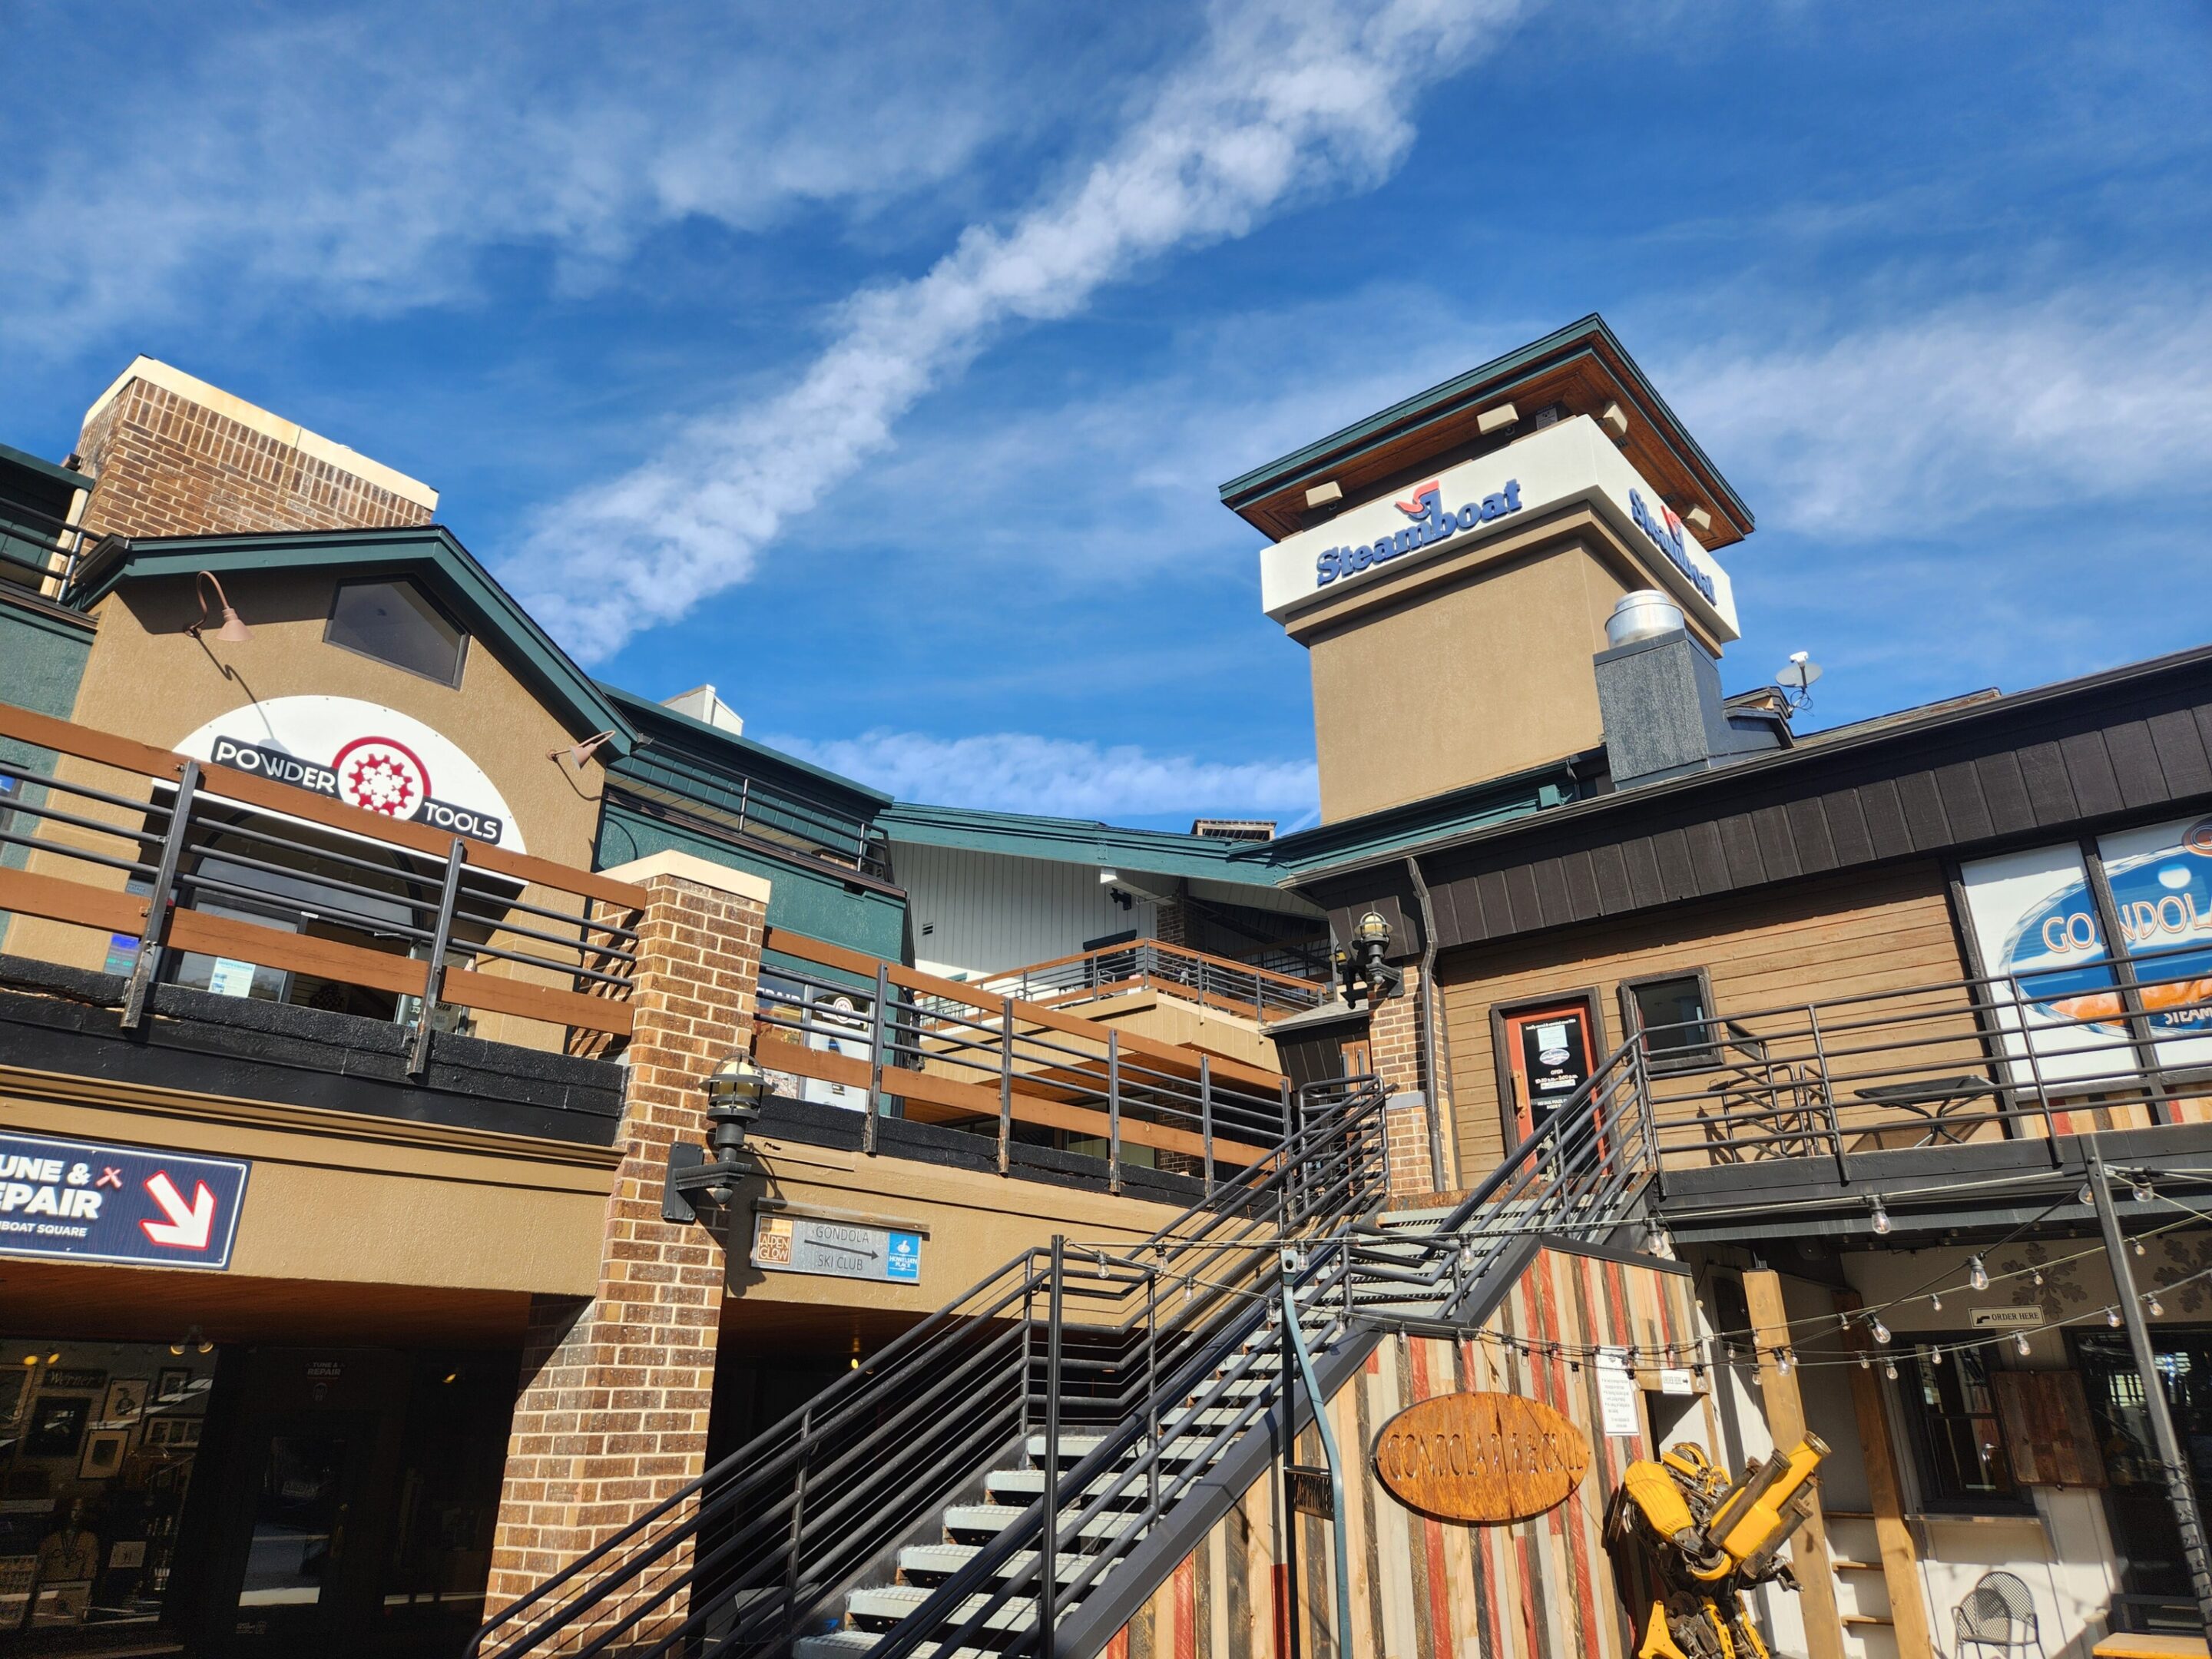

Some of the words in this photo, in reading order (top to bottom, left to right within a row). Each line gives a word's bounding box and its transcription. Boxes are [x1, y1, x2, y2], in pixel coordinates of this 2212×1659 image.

[1316, 478, 1522, 587] Steamboat
[1628, 487, 1717, 606] Steamboat
[215, 741, 336, 794] POWDER
[424, 801, 498, 839] TOOLS
[2042, 893, 2212, 953] GONDOL
[67, 1163, 91, 1187] &
[0, 1220, 36, 1233] BOAT
[37, 1224, 88, 1237] SQUARE
[816, 1226, 869, 1243] GONDOLA
[759, 1233, 790, 1250] ALPEN
[759, 1246, 788, 1260] GLOW
[817, 1254, 833, 1268] SKI
[836, 1257, 863, 1270] CLUB
[1992, 1313, 2018, 1321] ORDER
[307, 1368, 341, 1376] REPAIR
